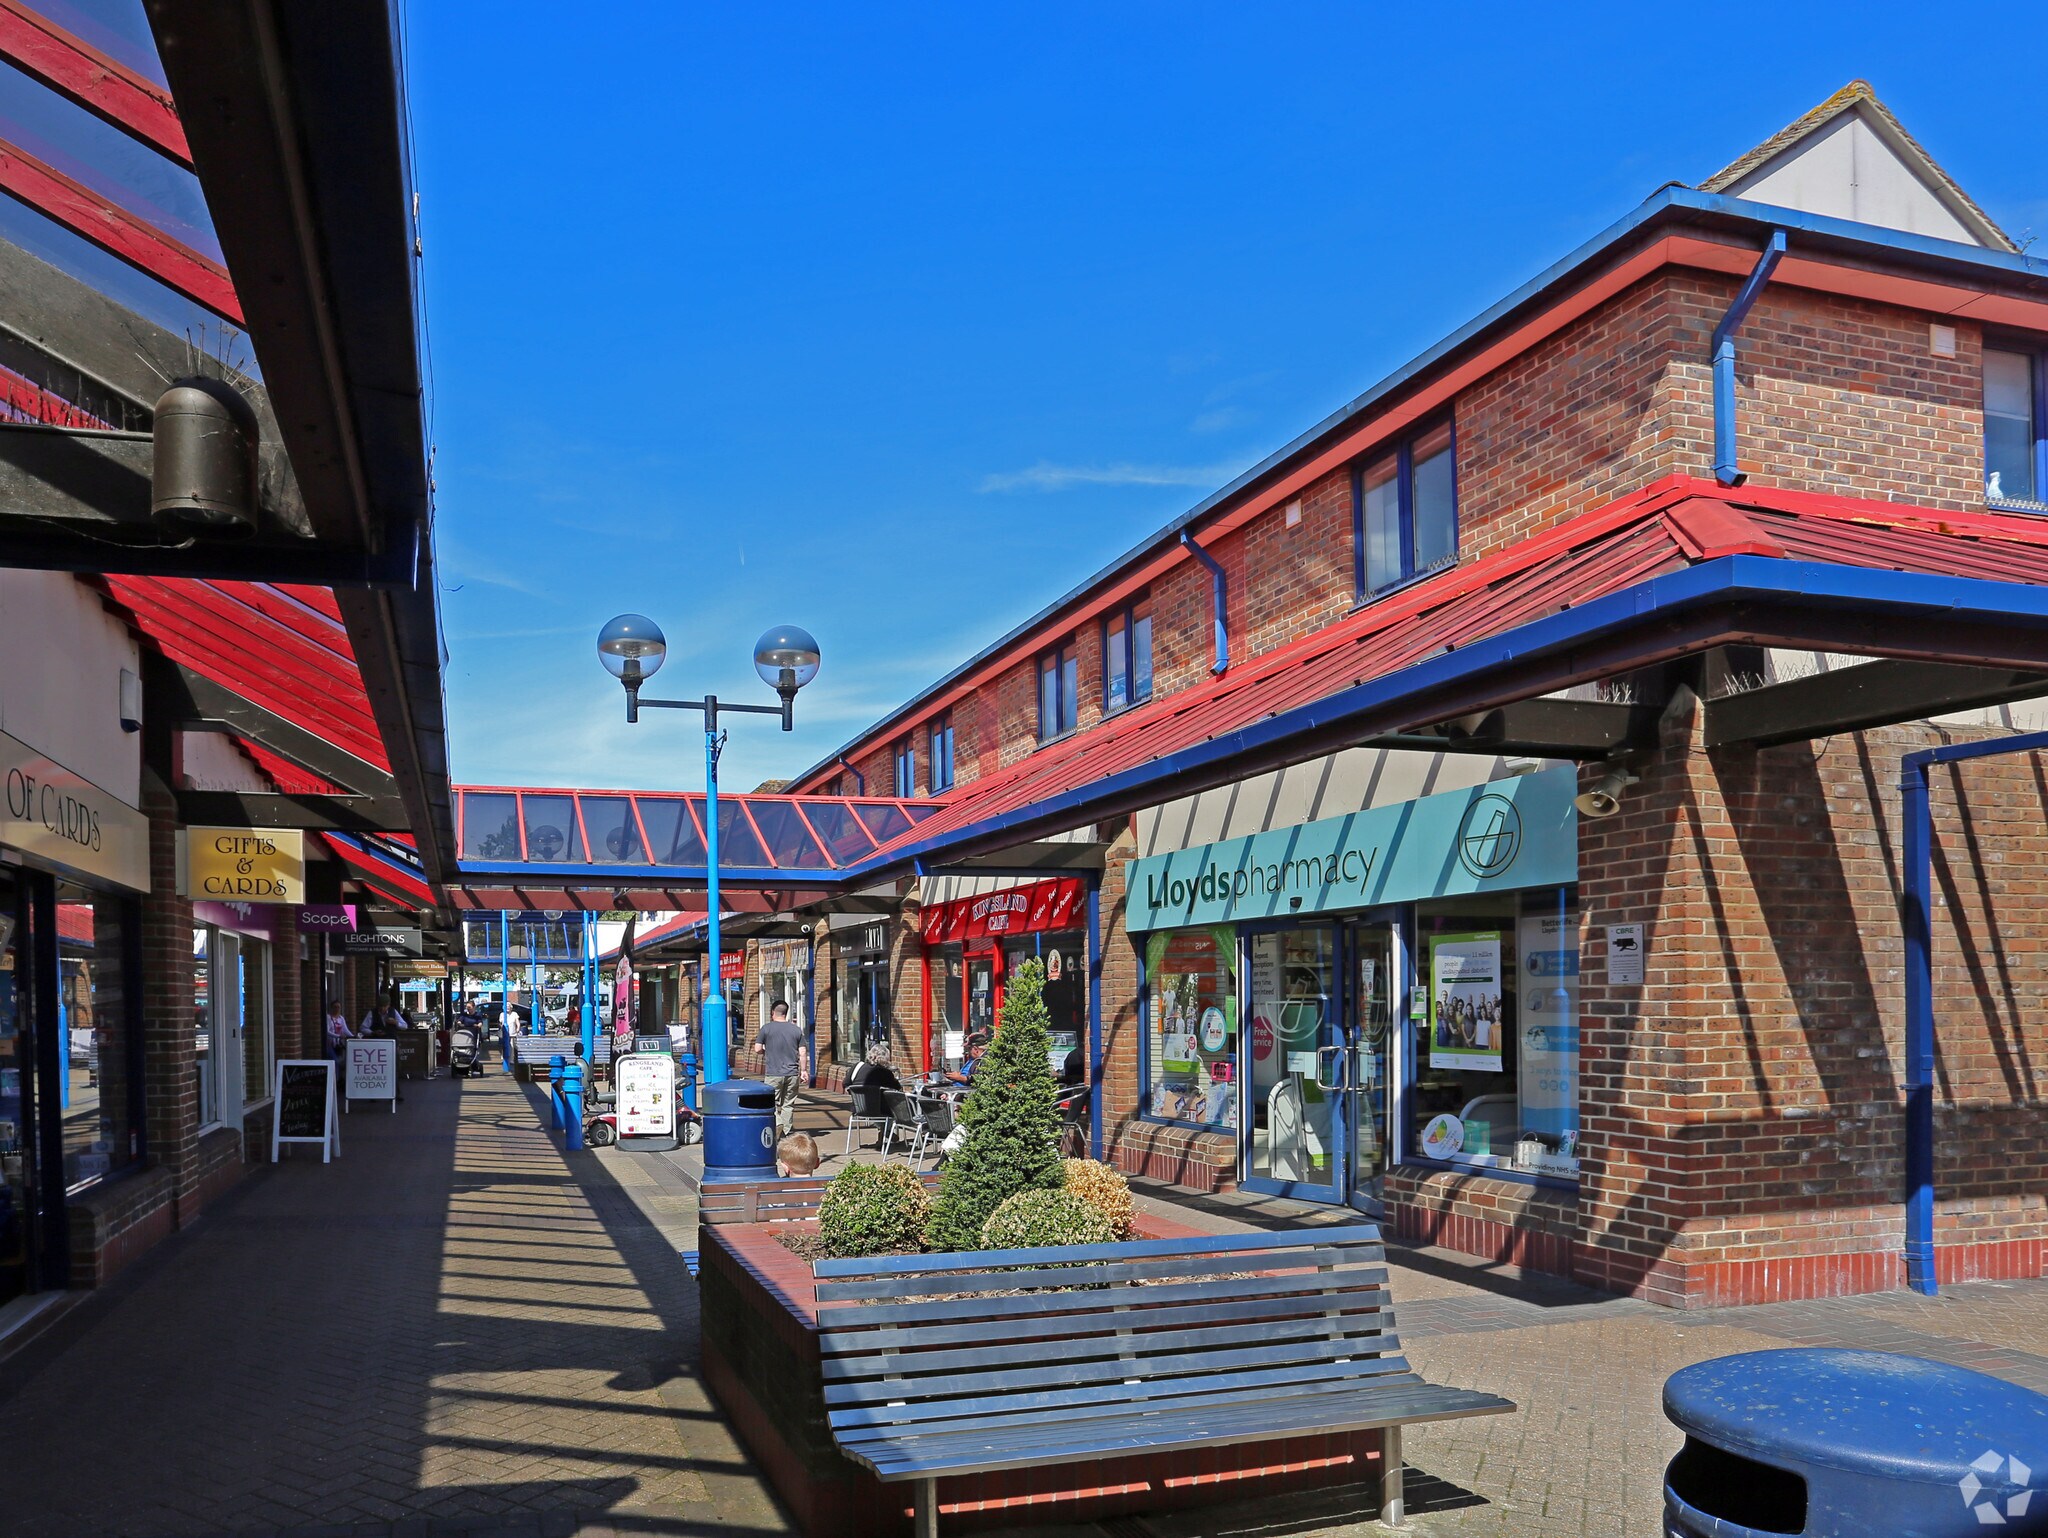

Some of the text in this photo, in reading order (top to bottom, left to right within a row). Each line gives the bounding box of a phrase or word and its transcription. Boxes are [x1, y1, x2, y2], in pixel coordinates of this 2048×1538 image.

[7, 768, 101, 853] OF CARDS
[215, 836, 277, 856] GIFTS
[236, 857, 254, 875] &
[203, 876, 287, 896] CARDS
[1147, 846, 1378, 914] Lloydspharmacy
[971, 893, 1028, 922] KINGSLAND
[302, 911, 350, 926] Scope
[344, 933, 405, 944] LEIGHTONS
[1254, 1026, 1268, 1036] Free
[1253, 1036, 1272, 1047] ervice
[353, 1048, 387, 1063] EYE
[354, 1064, 387, 1075] TEST
[354, 1081, 387, 1089] TODAY
[1529, 1161, 1556, 1174] Providing
[1556, 1165, 1569, 1174] NHS
